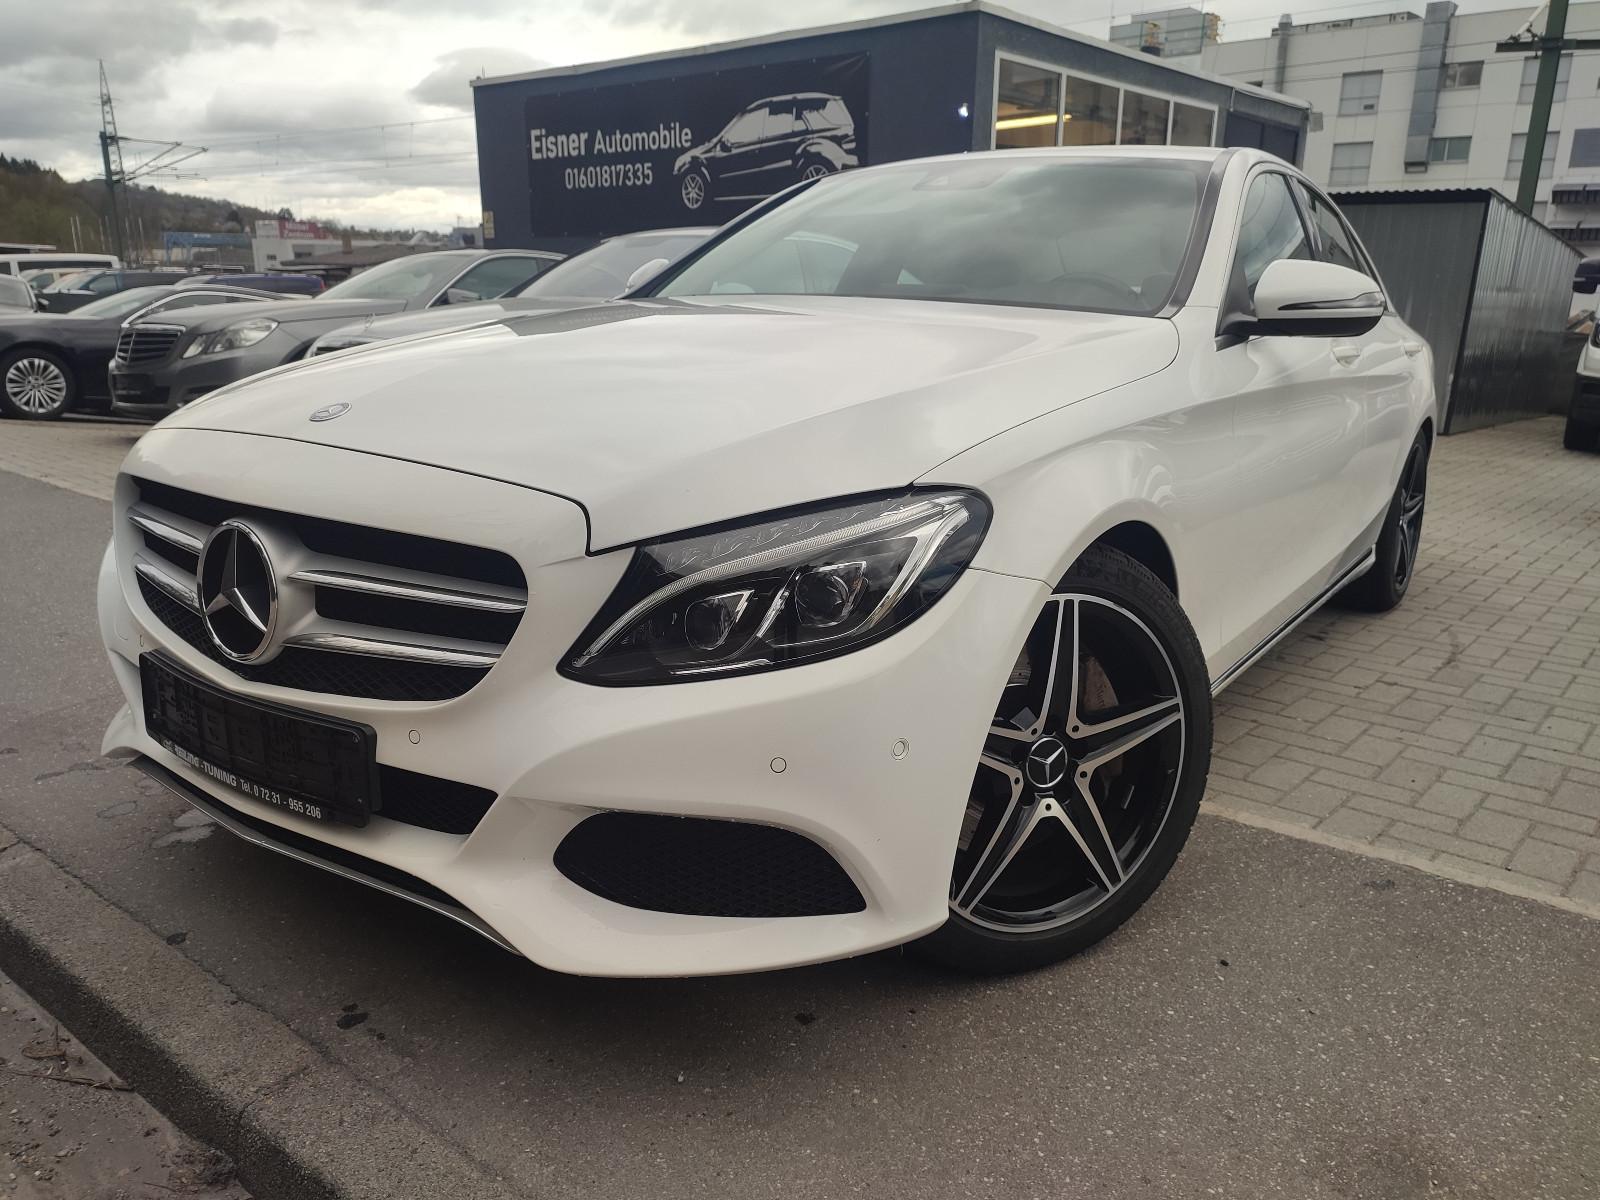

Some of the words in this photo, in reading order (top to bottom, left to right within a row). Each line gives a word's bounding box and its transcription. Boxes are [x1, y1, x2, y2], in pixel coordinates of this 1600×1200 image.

[530, 129, 588, 160] Eisner
[594, 122, 692, 154] Automobile
[565, 163, 653, 189] 01601817335
[240, 779, 253, 795] Tel.
[288, 798, 304, 813] 955
[305, 804, 321, 819] 206
